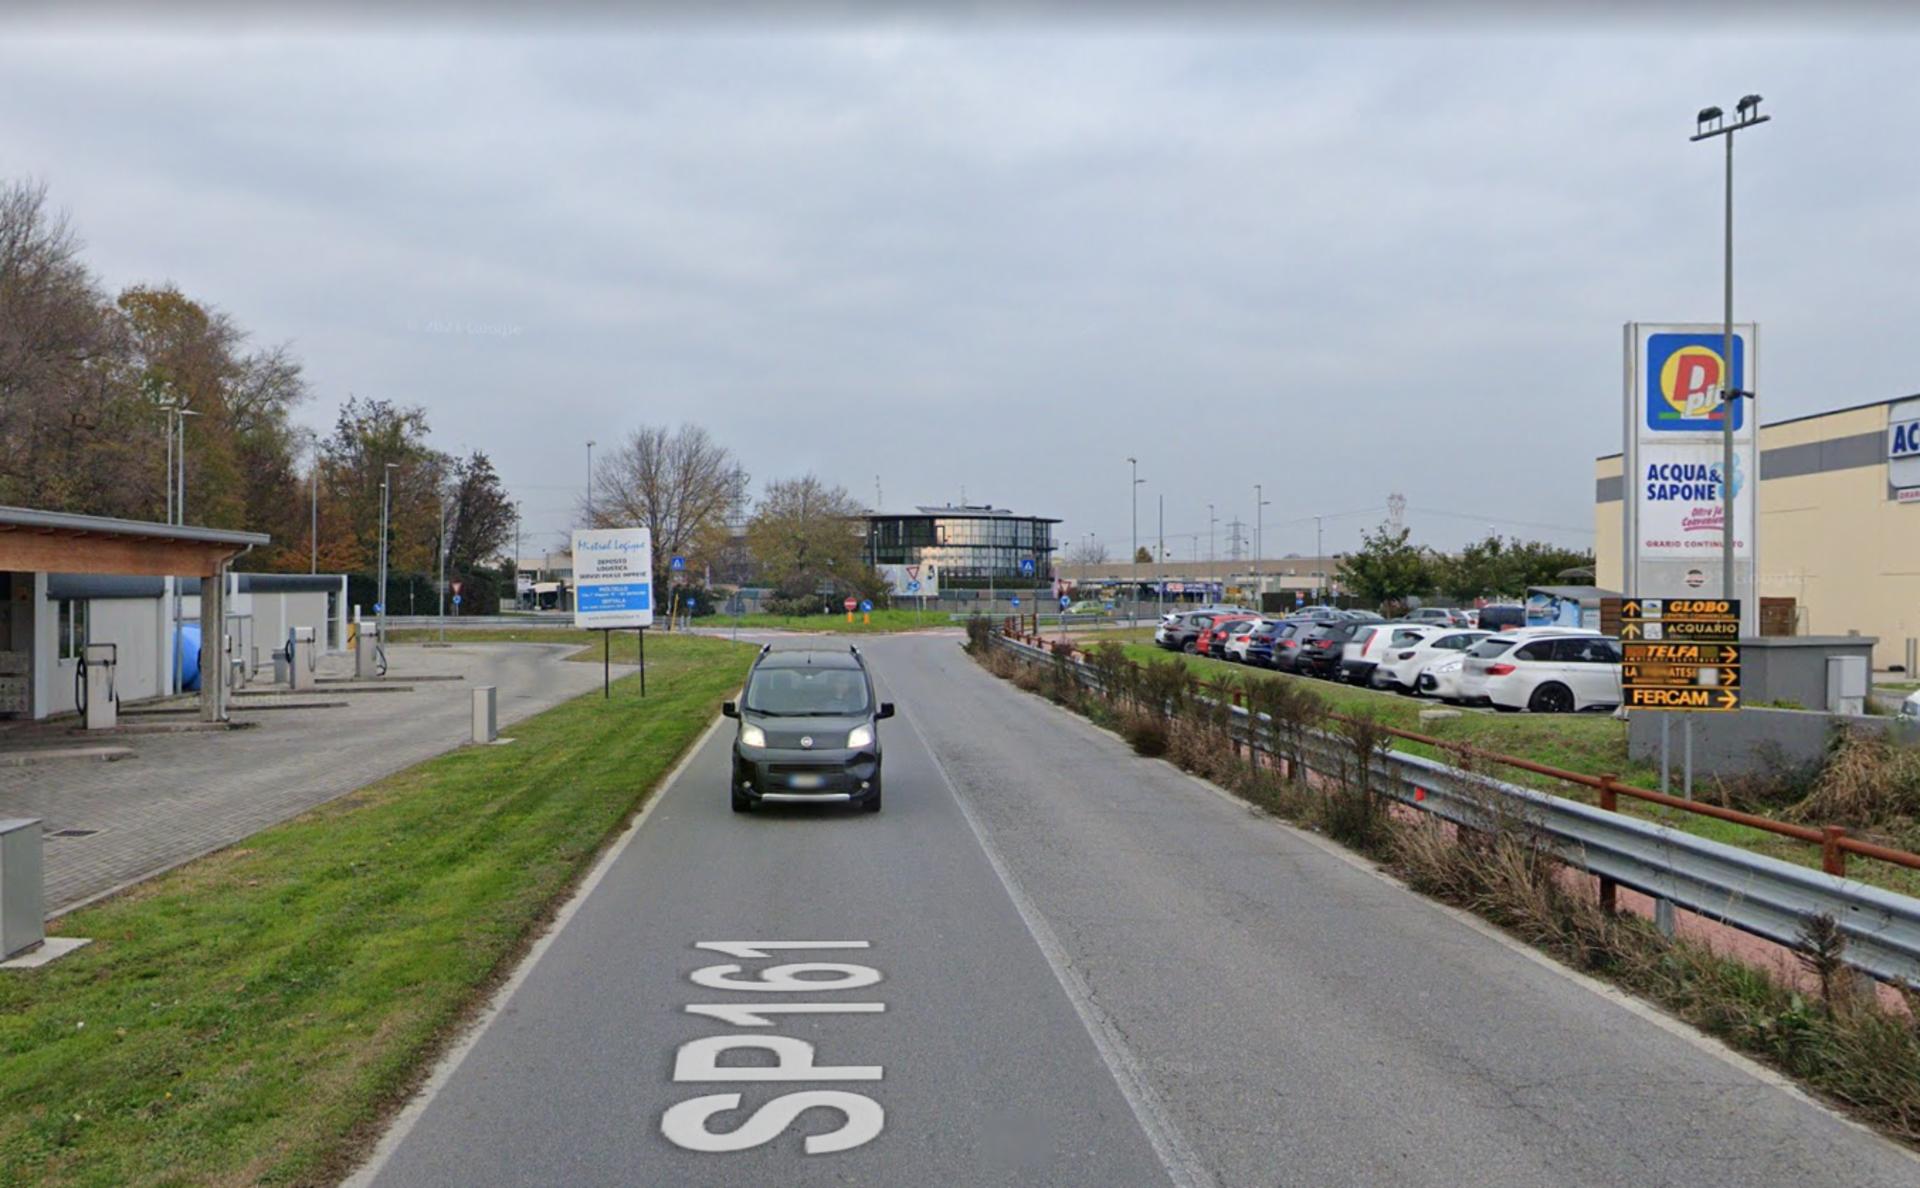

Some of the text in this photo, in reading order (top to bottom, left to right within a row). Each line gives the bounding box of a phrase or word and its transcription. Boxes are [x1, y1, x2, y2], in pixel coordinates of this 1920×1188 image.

[1892, 422, 1920, 454] AC
[1647, 484, 1716, 500] SAPONE
[1646, 540, 1681, 548] ORARIO
[1670, 601, 1729, 612] GLOBO
[1668, 623, 1737, 633] ACQUARIO
[1647, 646, 1698, 657] TELFA
[1634, 690, 1709, 706] FERCAM
[661, 940, 885, 1154] SP161
